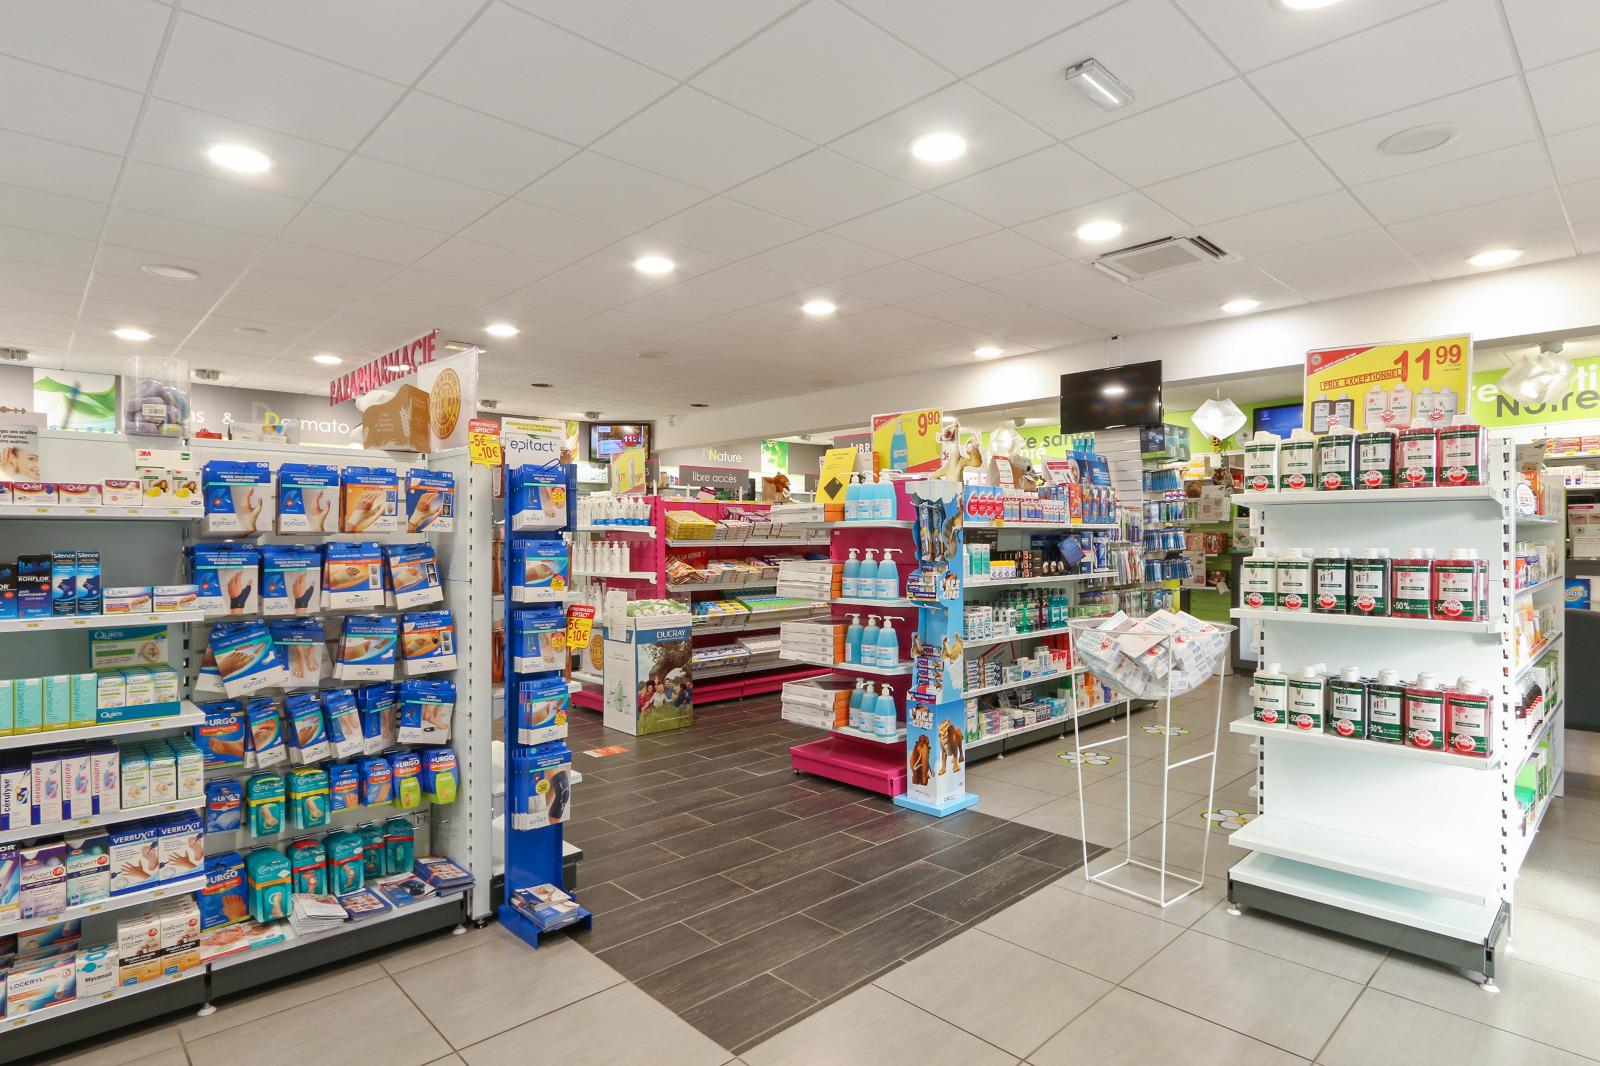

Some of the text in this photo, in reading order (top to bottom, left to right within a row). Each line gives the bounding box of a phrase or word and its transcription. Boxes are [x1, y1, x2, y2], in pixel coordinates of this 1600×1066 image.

[1322, 380, 1341, 391] PRIX
[222, 412, 235, 425] &
[470, 434, 488, 447] -5€
[510, 439, 552, 453] epitact
[478, 446, 499, 459] -10€
[708, 449, 743, 463] Nature
[692, 470, 738, 484] libre accès
[77, 551, 99, 559] Silence
[17, 575, 49, 583] RONFLOR
[1393, 601, 1410, 611] -50%
[94, 630, 124, 640] Quies
[568, 630, 588, 642] -10€
[656, 629, 687, 639] DUCRAY
[100, 710, 122, 719] Quies
[208, 716, 237, 727] URGO
[1369, 725, 1384, 734] -50%
[399, 759, 420, 768] URGO
[435, 755, 455, 763] URGO
[373, 769, 391, 777] URGO
[339, 778, 357, 786] URGO
[257, 861, 289, 875] Compeed
[209, 869, 238, 884] URGO
